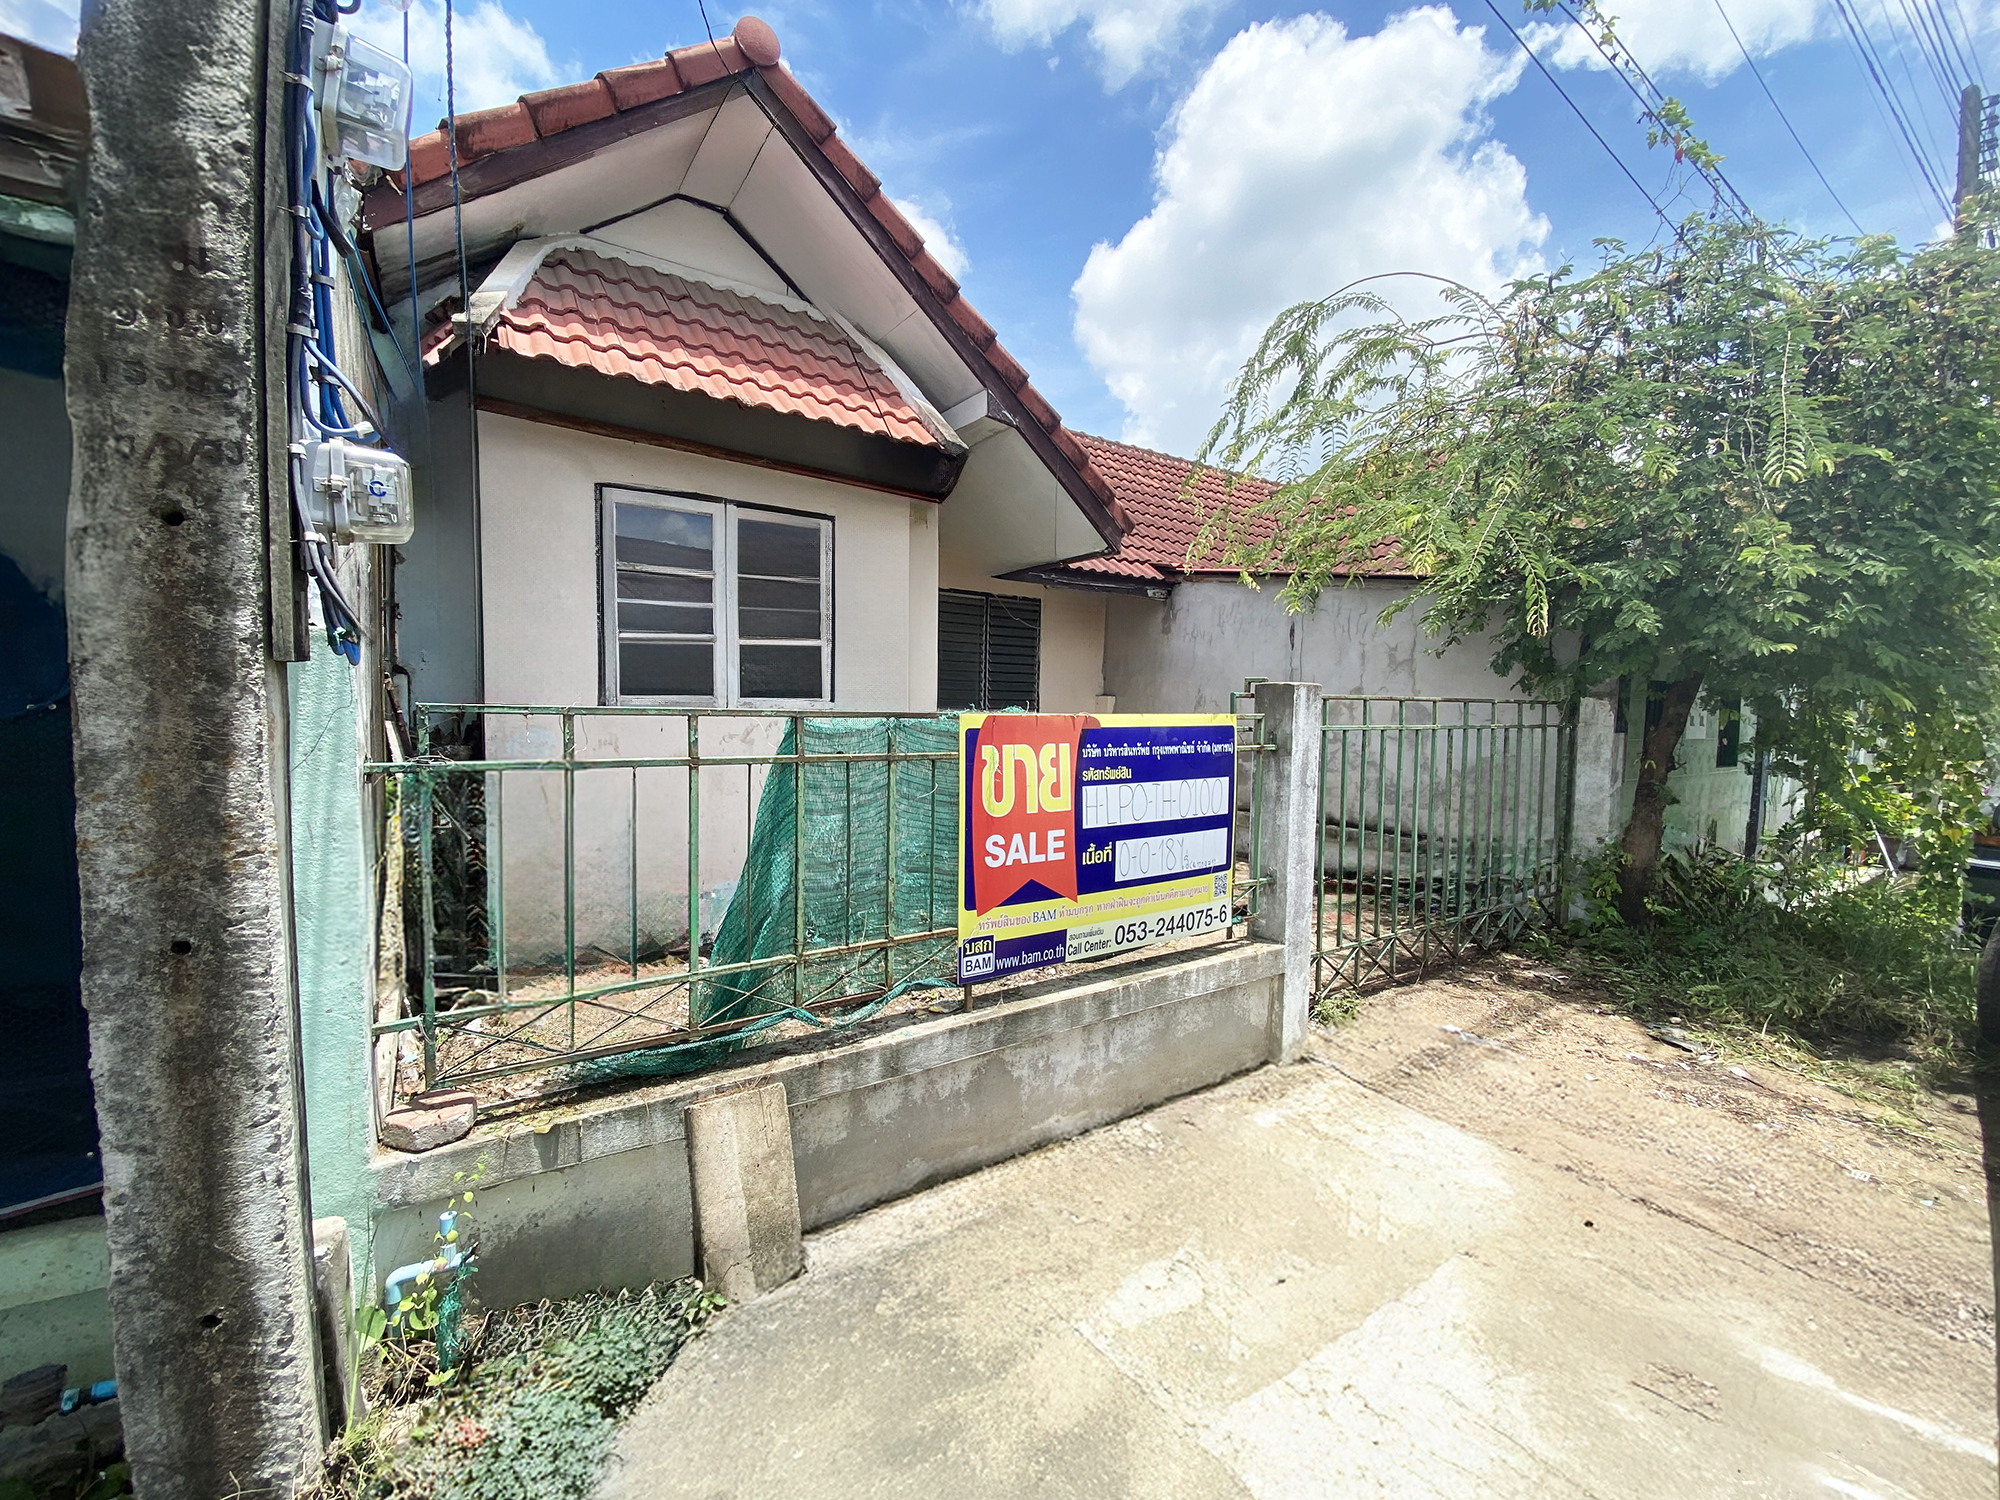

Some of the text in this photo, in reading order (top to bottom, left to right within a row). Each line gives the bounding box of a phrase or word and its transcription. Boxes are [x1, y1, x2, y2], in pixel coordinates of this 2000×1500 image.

[1082, 742, 1101, 758] บริษัท
[1104, 741, 1150, 758] บริหารสินทรัพย์
[1197, 740, 1210, 753] จำกัด
[1212, 742, 1234, 755] (มหาชน)
[982, 743, 1071, 817] ขาย
[1082, 765, 1132, 781] รหัสทรัพย์สิน
[984, 829, 1065, 868] SALE
[1082, 842, 1112, 866] เนื้อที่
[978, 913, 1031, 931] ทรัพย์สินของ
[1032, 908, 1057, 923] BAM
[1059, 905, 1094, 919] ห้ามบุกรุก
[1115, 904, 1228, 945] 053-244075-6
[965, 939, 992, 955] บสก
[996, 944, 1065, 970] www.bam.co.th
[1067, 938, 1112, 956] Call Center:
[965, 956, 992, 973] BAM
